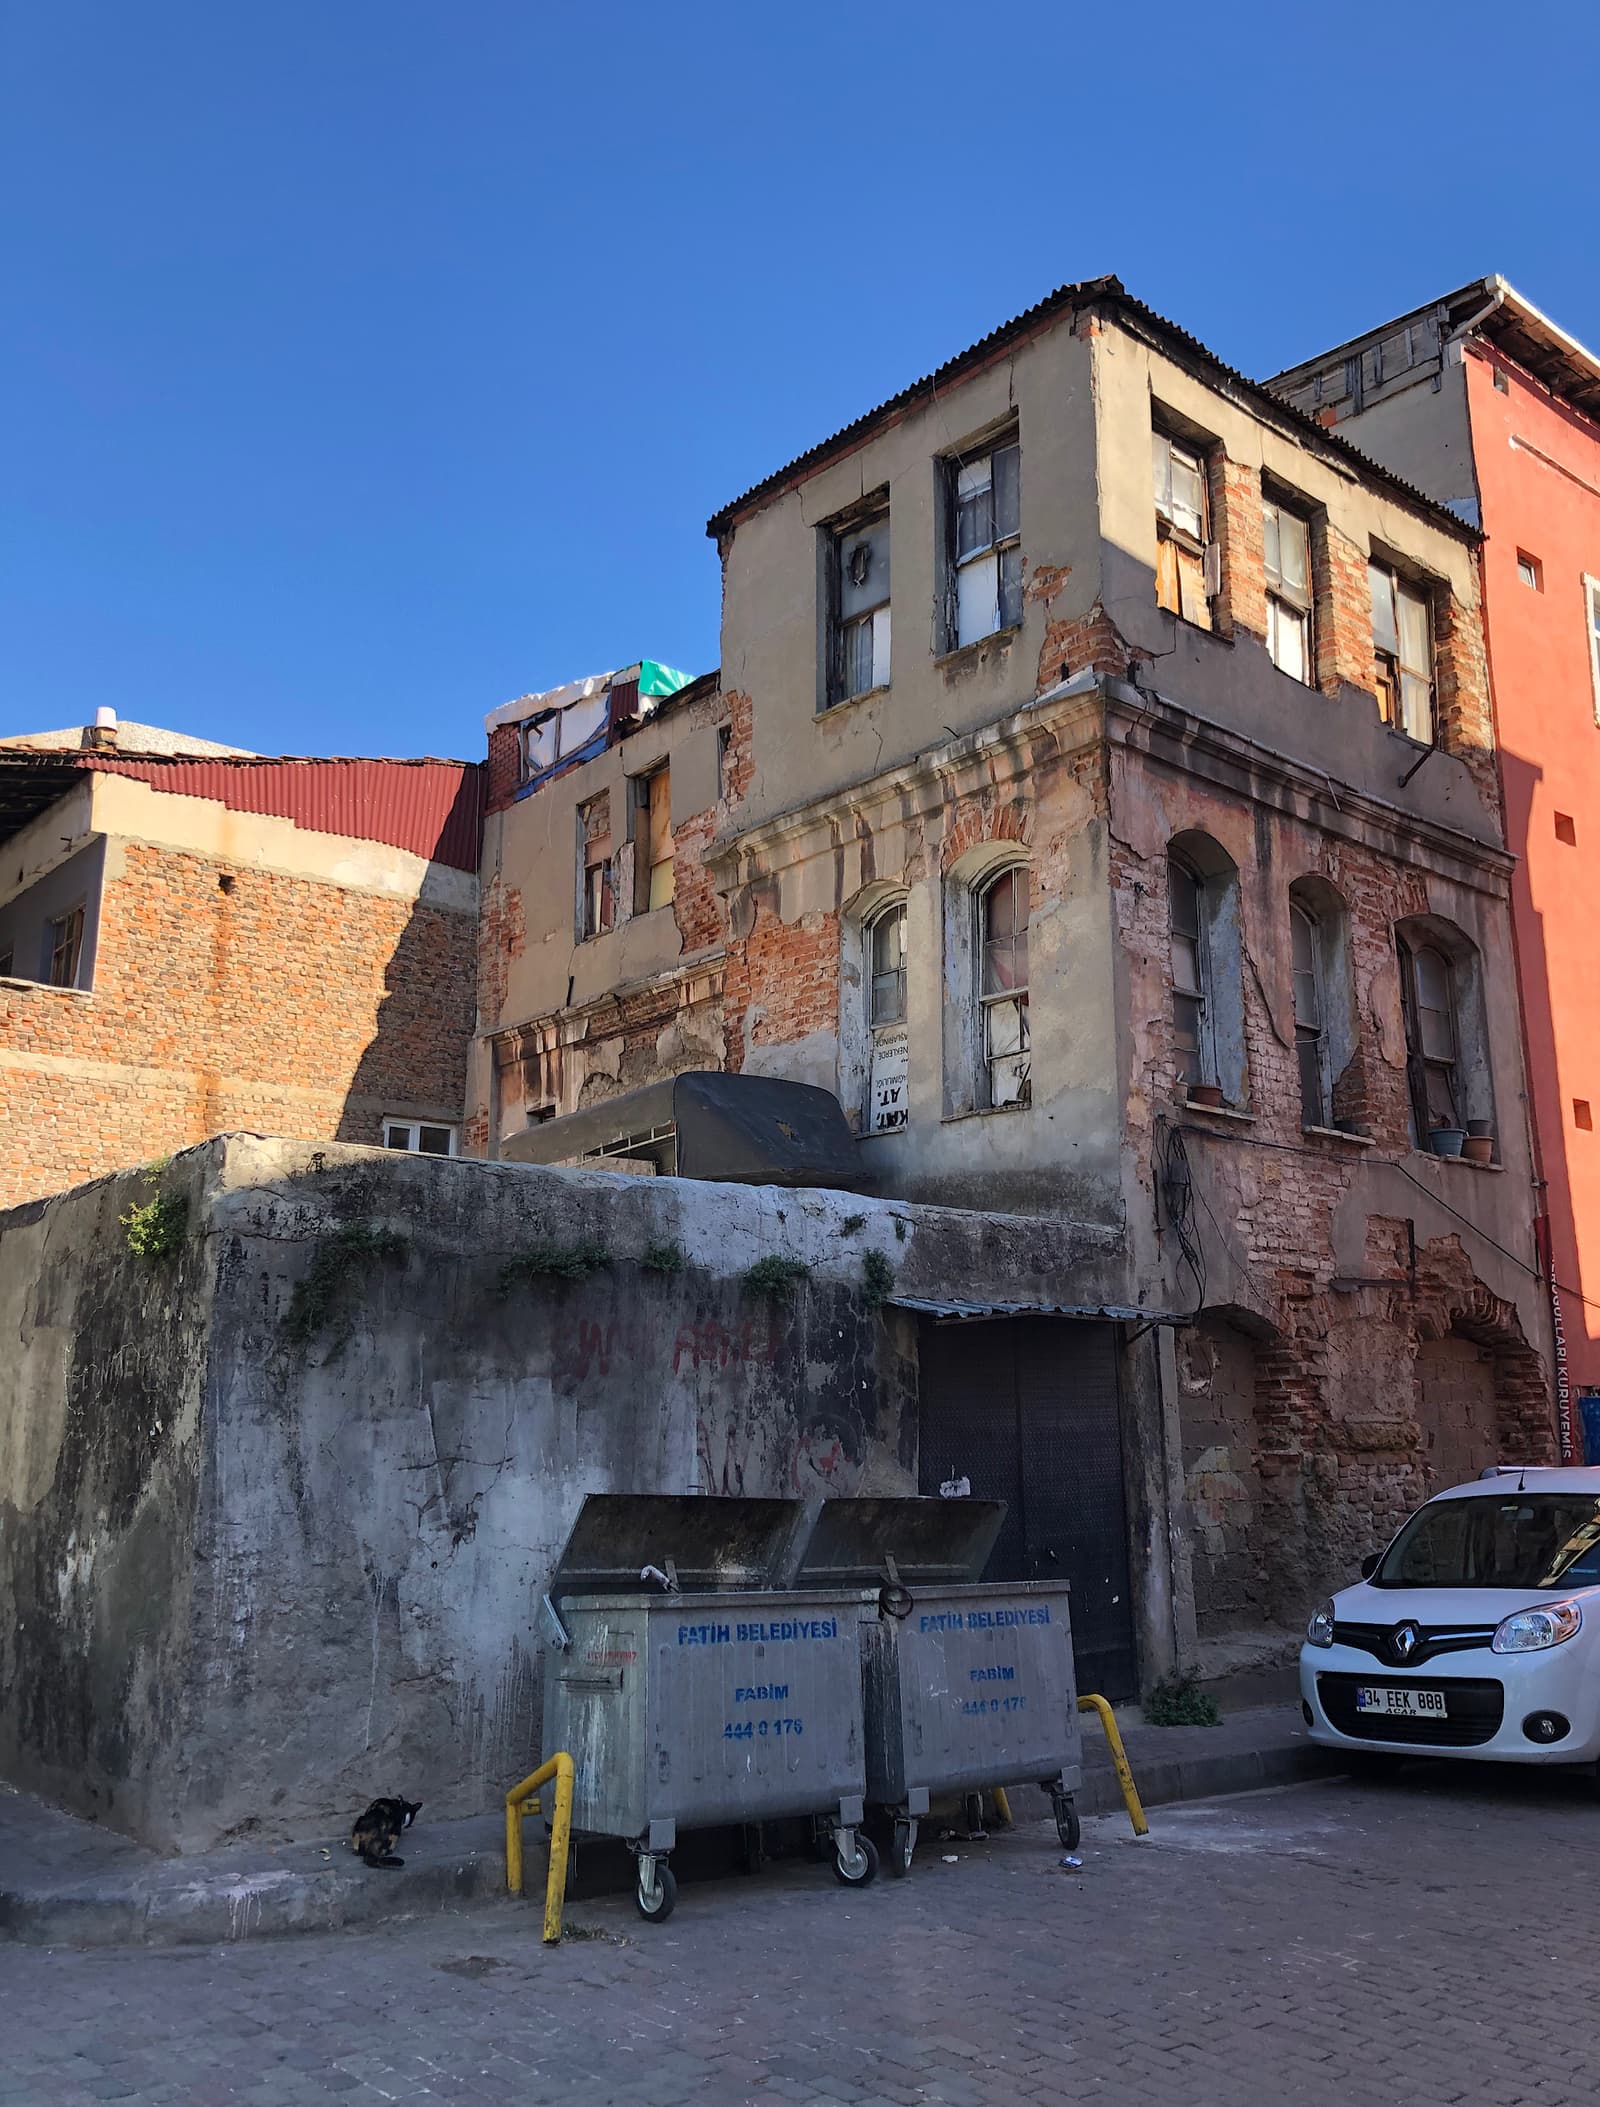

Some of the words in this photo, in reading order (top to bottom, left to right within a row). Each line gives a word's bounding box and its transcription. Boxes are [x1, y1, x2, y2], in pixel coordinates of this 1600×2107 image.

[920, 1610, 963, 1633] FATİH
[968, 1604, 1051, 1629] BELEDİYESİ
[678, 1621, 730, 1646] FATİH
[736, 1617, 837, 1642] BELEDİYESİ
[969, 1665, 1015, 1682] FABİM
[735, 1683, 789, 1702] FABİM
[1365, 1689, 1381, 1707] 34
[1387, 1691, 1411, 1709] EEK
[1418, 1693, 1443, 1710] 888
[1386, 1708, 1417, 1716] ACAR
